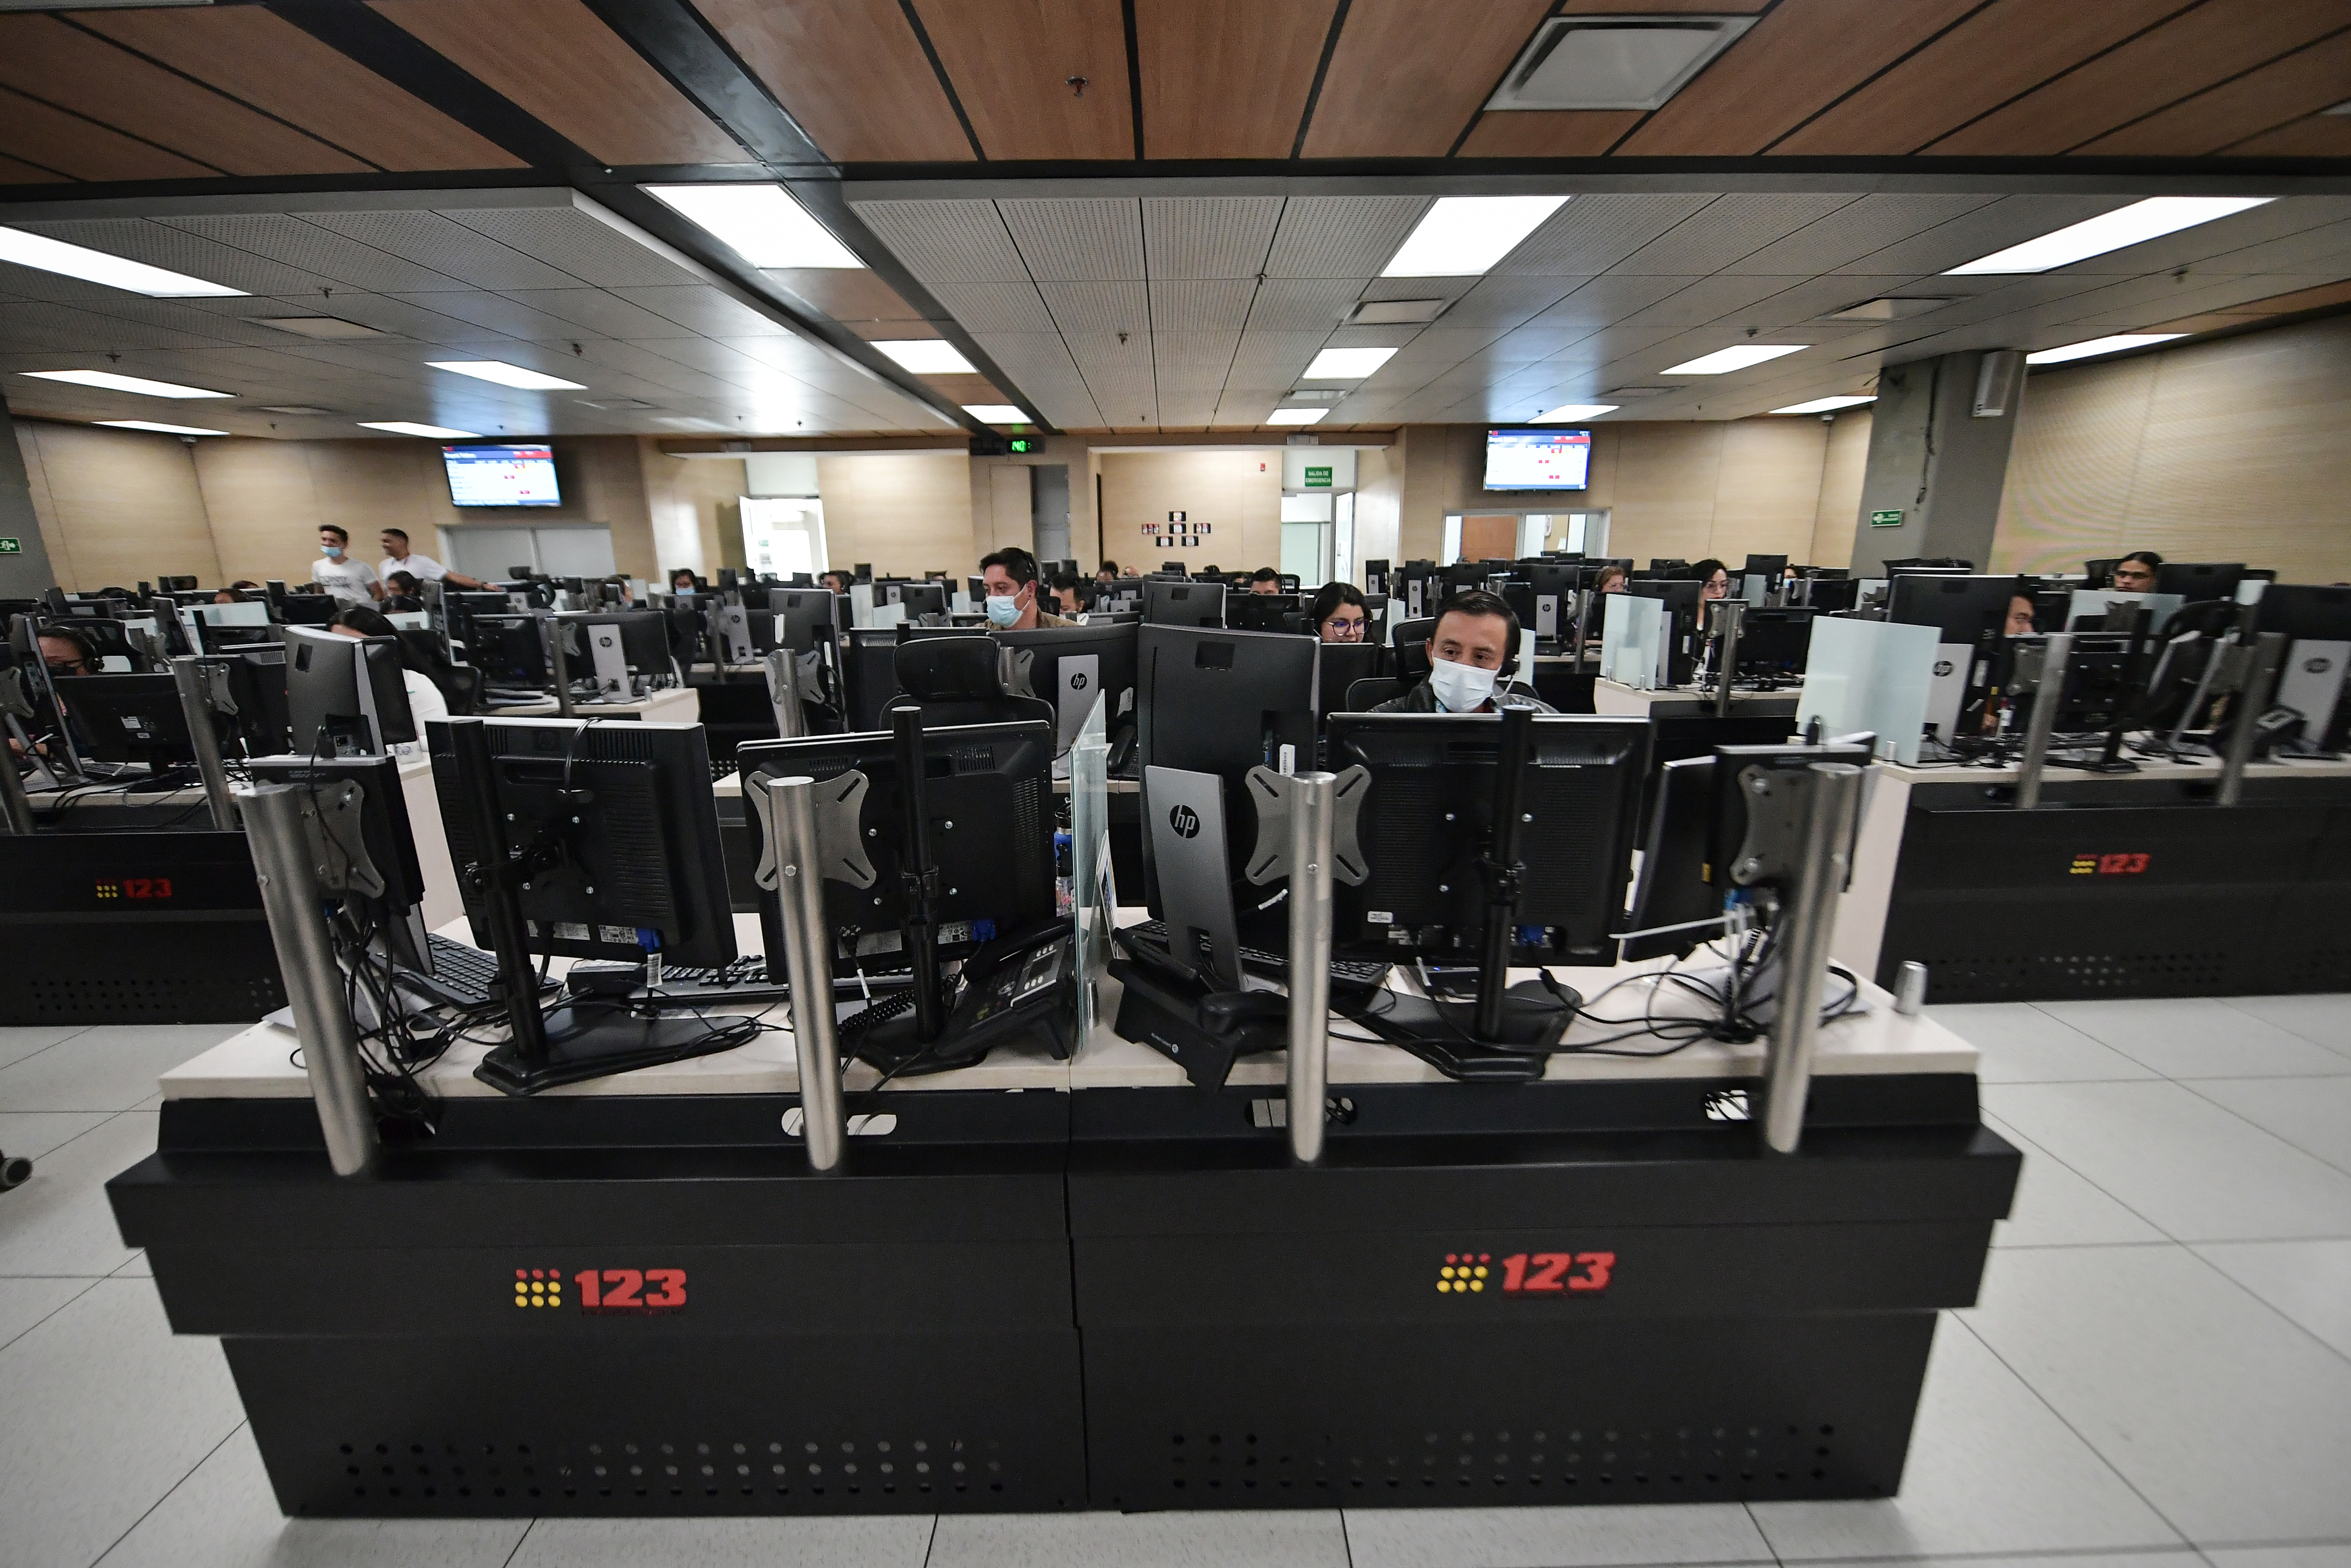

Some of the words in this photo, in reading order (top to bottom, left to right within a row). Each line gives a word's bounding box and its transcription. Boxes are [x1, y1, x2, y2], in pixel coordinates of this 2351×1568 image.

[1071, 673, 1086, 690] hp
[1172, 804, 1198, 838] hp
[2098, 853, 2151, 873] 123
[123, 878, 172, 898] 123
[1502, 1252, 1616, 1291] 123
[574, 1269, 687, 1307] 123
